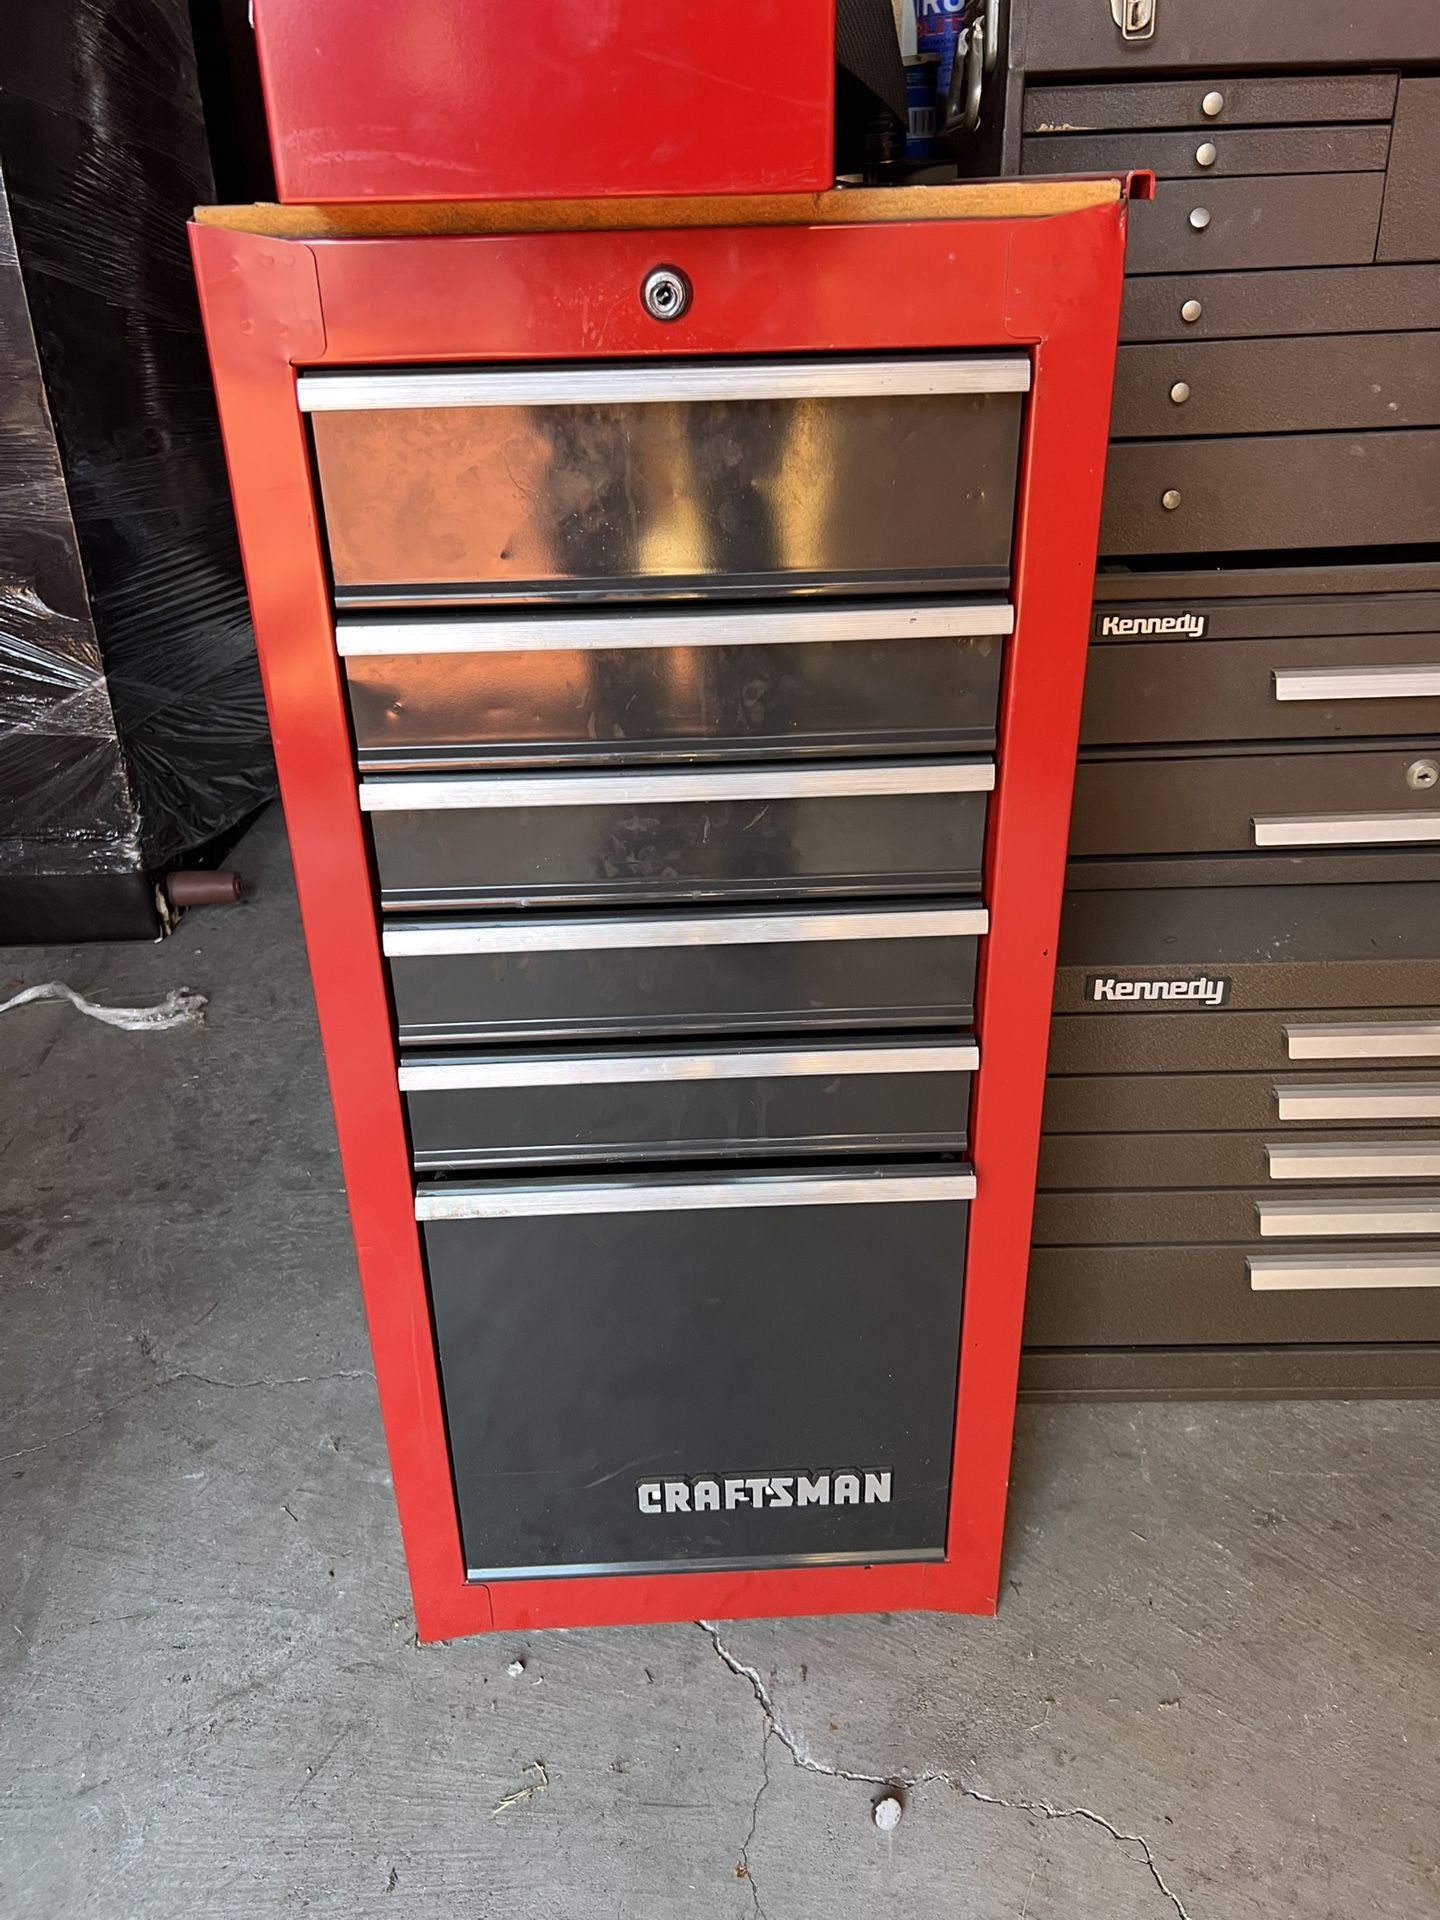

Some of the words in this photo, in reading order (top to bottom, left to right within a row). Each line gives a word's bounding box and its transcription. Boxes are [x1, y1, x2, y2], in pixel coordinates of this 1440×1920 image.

[1102, 614, 1204, 637] Kennedy
[1093, 977, 1224, 1005] Kennedy
[637, 1472, 892, 1514] CRAFTSMAN
